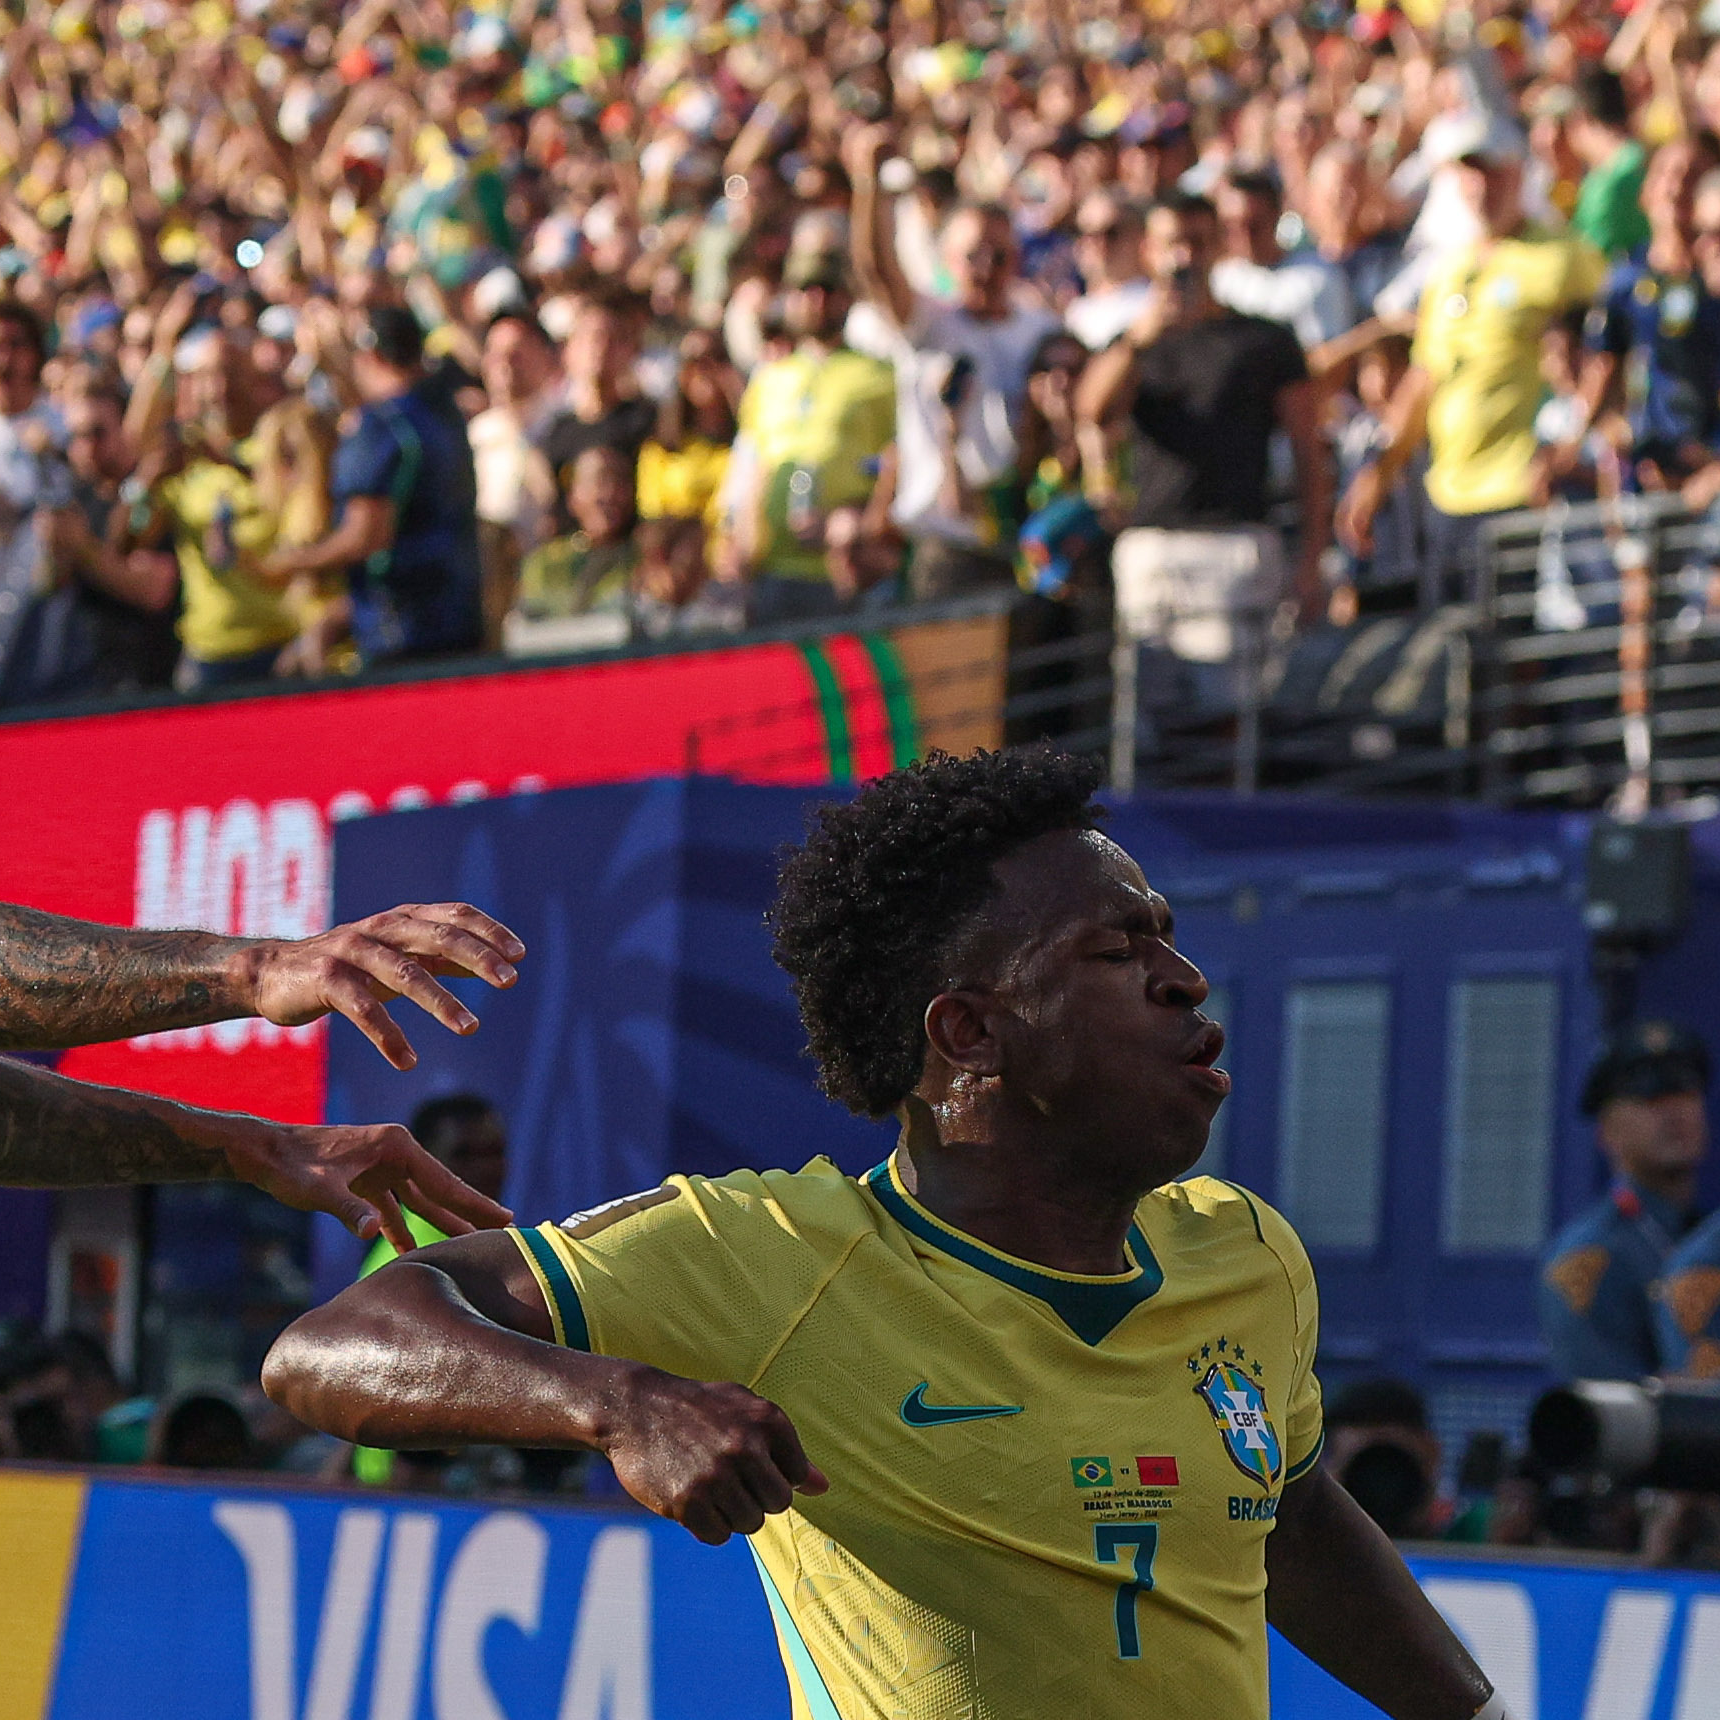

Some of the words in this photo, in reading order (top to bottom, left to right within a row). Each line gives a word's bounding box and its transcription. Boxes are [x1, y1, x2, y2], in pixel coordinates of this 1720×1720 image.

[1234, 1411, 1258, 1429] CBF
[1084, 1501, 1113, 1511] BRASIL
[1092, 1522, 1160, 1660] 7
